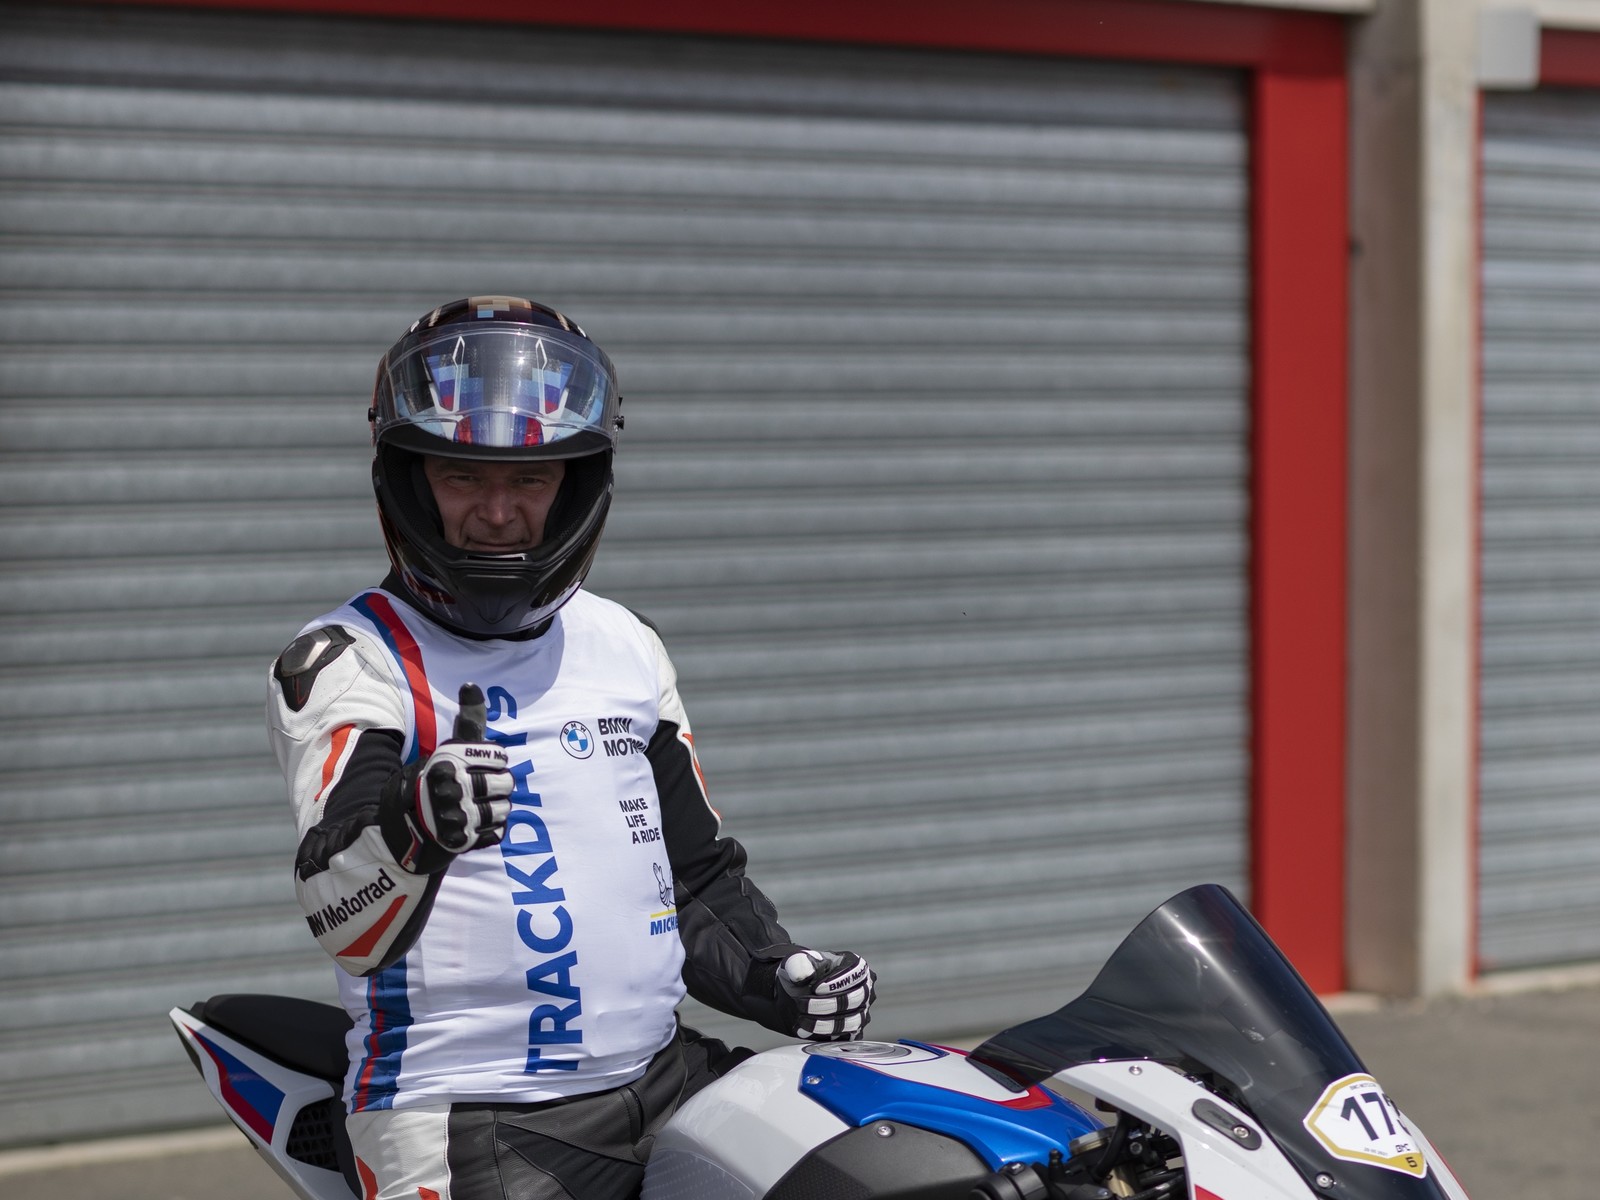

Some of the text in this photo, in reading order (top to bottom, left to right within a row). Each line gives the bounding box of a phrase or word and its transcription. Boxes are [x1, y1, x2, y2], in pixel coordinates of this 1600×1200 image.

[597, 717, 633, 736] BMW
[465, 748, 492, 759] BMW
[619, 797, 649, 813] MAKE
[625, 813, 648, 829] LIFE
[632, 827, 661, 845] A RIDE
[322, 867, 397, 931] Motorrad
[828, 976, 851, 992] BMW
